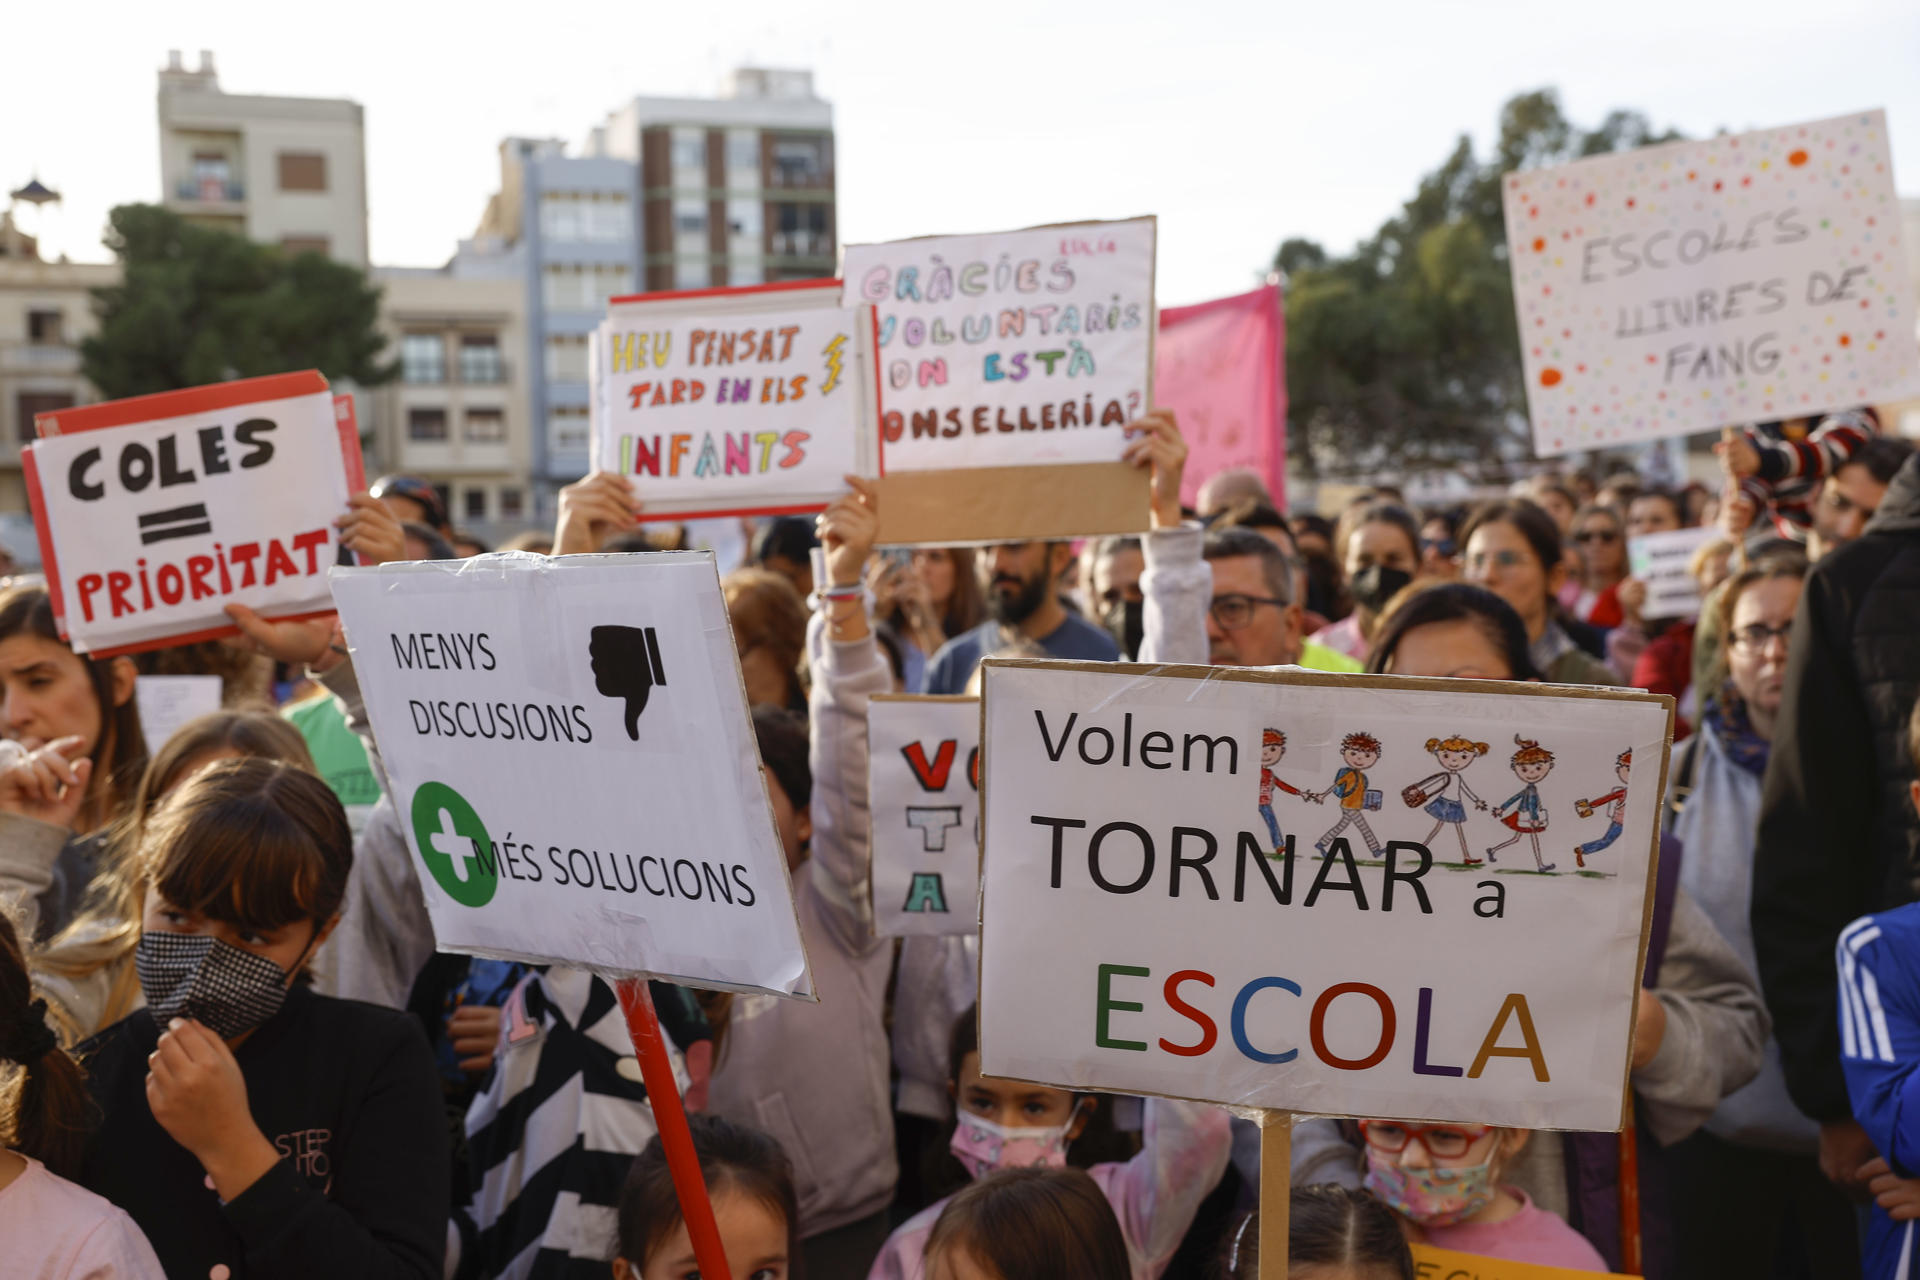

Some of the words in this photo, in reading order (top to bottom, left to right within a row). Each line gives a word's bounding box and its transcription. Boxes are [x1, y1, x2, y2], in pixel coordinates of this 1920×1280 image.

[1582, 206, 1811, 285] ESCOLES
[1805, 264, 1870, 307] DE
[612, 330, 672, 374] HEU
[688, 325, 801, 367] PENSAT
[983, 339, 1096, 382] ESTÀ
[1663, 331, 1783, 385] FANG
[628, 378, 706, 410] TARD
[715, 376, 752, 404] EN
[760, 373, 809, 405] ELS
[68, 417, 279, 502] COLES
[619, 429, 811, 479] INFANTS
[137, 501, 213, 546] =
[390, 631, 498, 672] MENYS
[408, 699, 593, 744] DISCUSIONS
[1033, 708, 1240, 775] Volem
[469, 831, 543, 882] MÉS
[547, 845, 757, 908] SOLUCIONS
[1030, 815, 1435, 915] TORNAR
[1472, 879, 1508, 919] a
[1094, 963, 1552, 1084] ESCOLA
[274, 1128, 333, 1160] STEP
